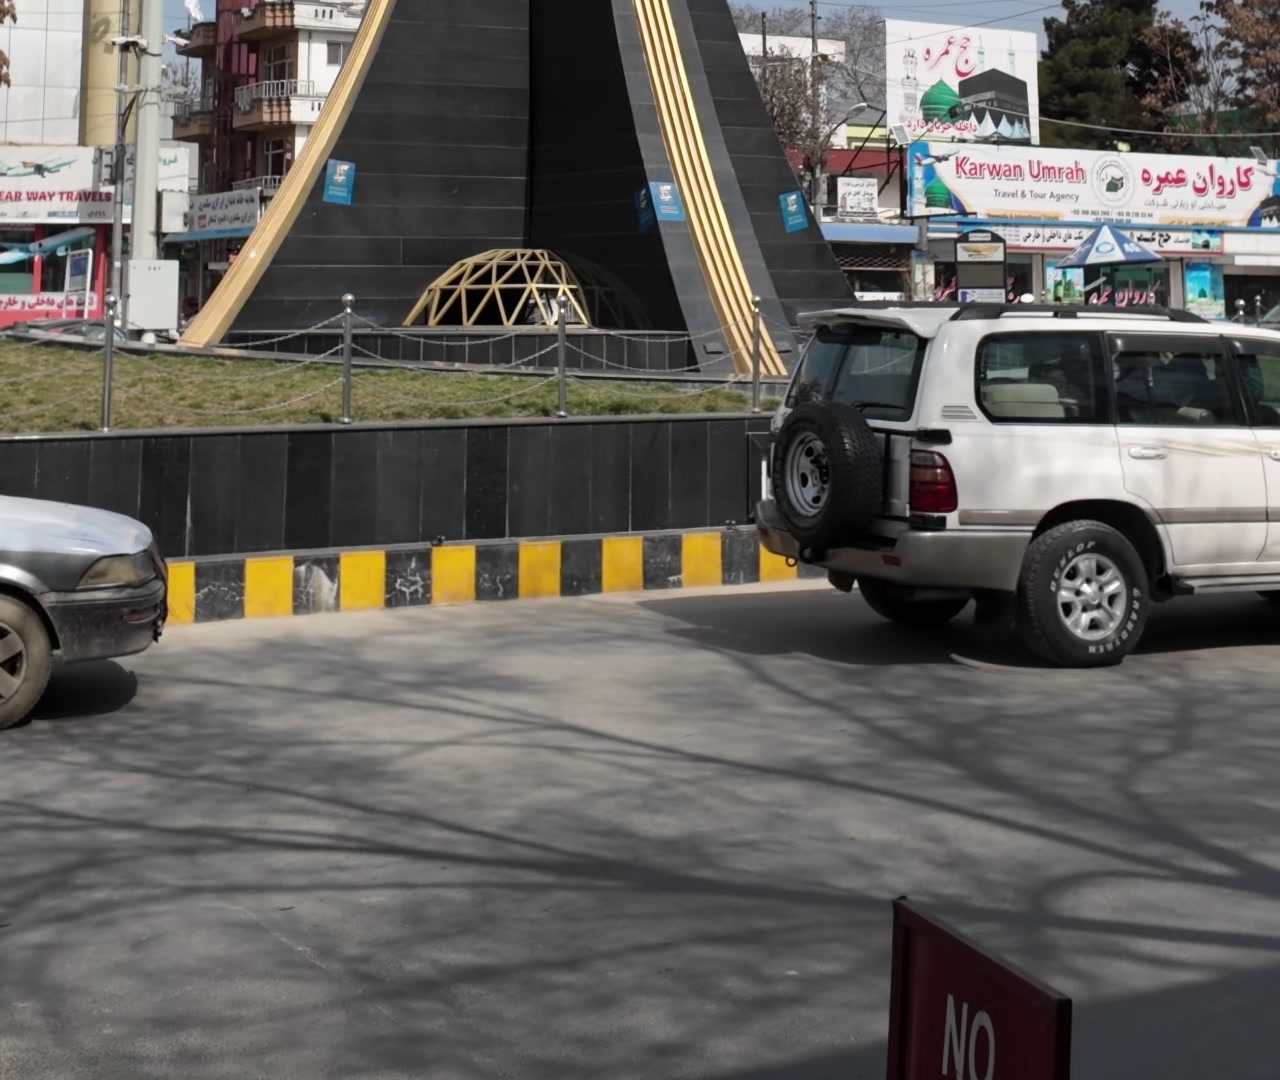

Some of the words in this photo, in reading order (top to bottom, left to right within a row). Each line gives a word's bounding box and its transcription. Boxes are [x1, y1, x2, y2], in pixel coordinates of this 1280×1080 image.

[924, 35, 955, 71] عمره
[955, 36, 976, 78] حج
[955, 156, 1024, 180] Karwan
[1028, 159, 1086, 183] Umrah
[1141, 167, 1188, 195] عمره
[1192, 164, 1253, 197] کاروان
[26, 191, 56, 203] WAY
[58, 191, 113, 203] TRAVELS
[994, 189, 1018, 199] Travel
[1020, 190, 1027, 199] &
[1029, 190, 1047, 200] Tour
[1049, 192, 1080, 203] Agency
[942, 992, 995, 1080] NO
